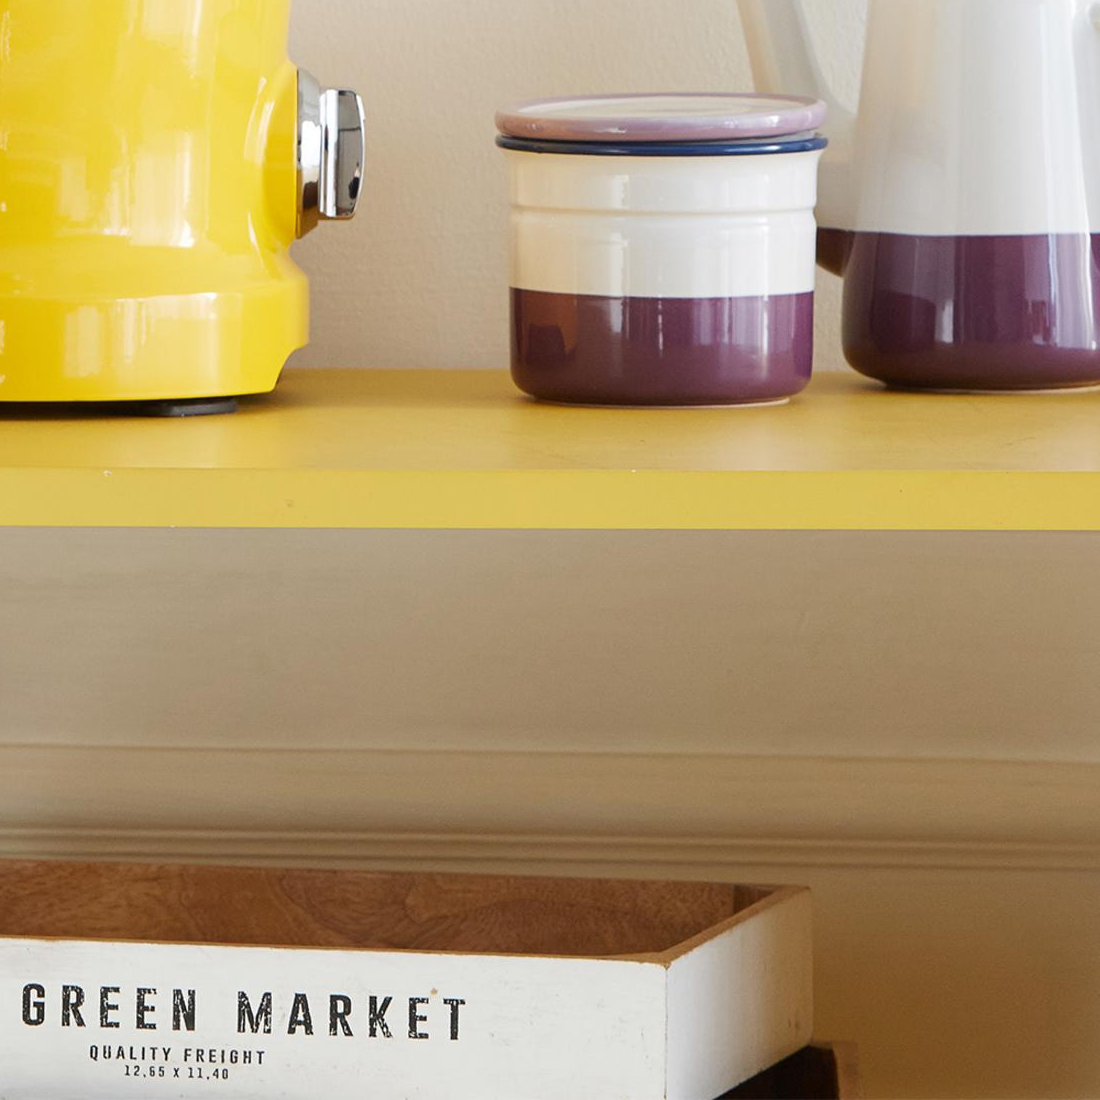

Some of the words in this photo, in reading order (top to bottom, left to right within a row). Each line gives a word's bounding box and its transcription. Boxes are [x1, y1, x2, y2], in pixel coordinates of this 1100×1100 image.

[21, 982, 198, 1033] GREEN
[236, 989, 466, 1042] MARKET
[89, 1043, 173, 1063] QUALITY
[182, 1046, 266, 1066] FREIGHT
[172, 1066, 181, 1078] X
